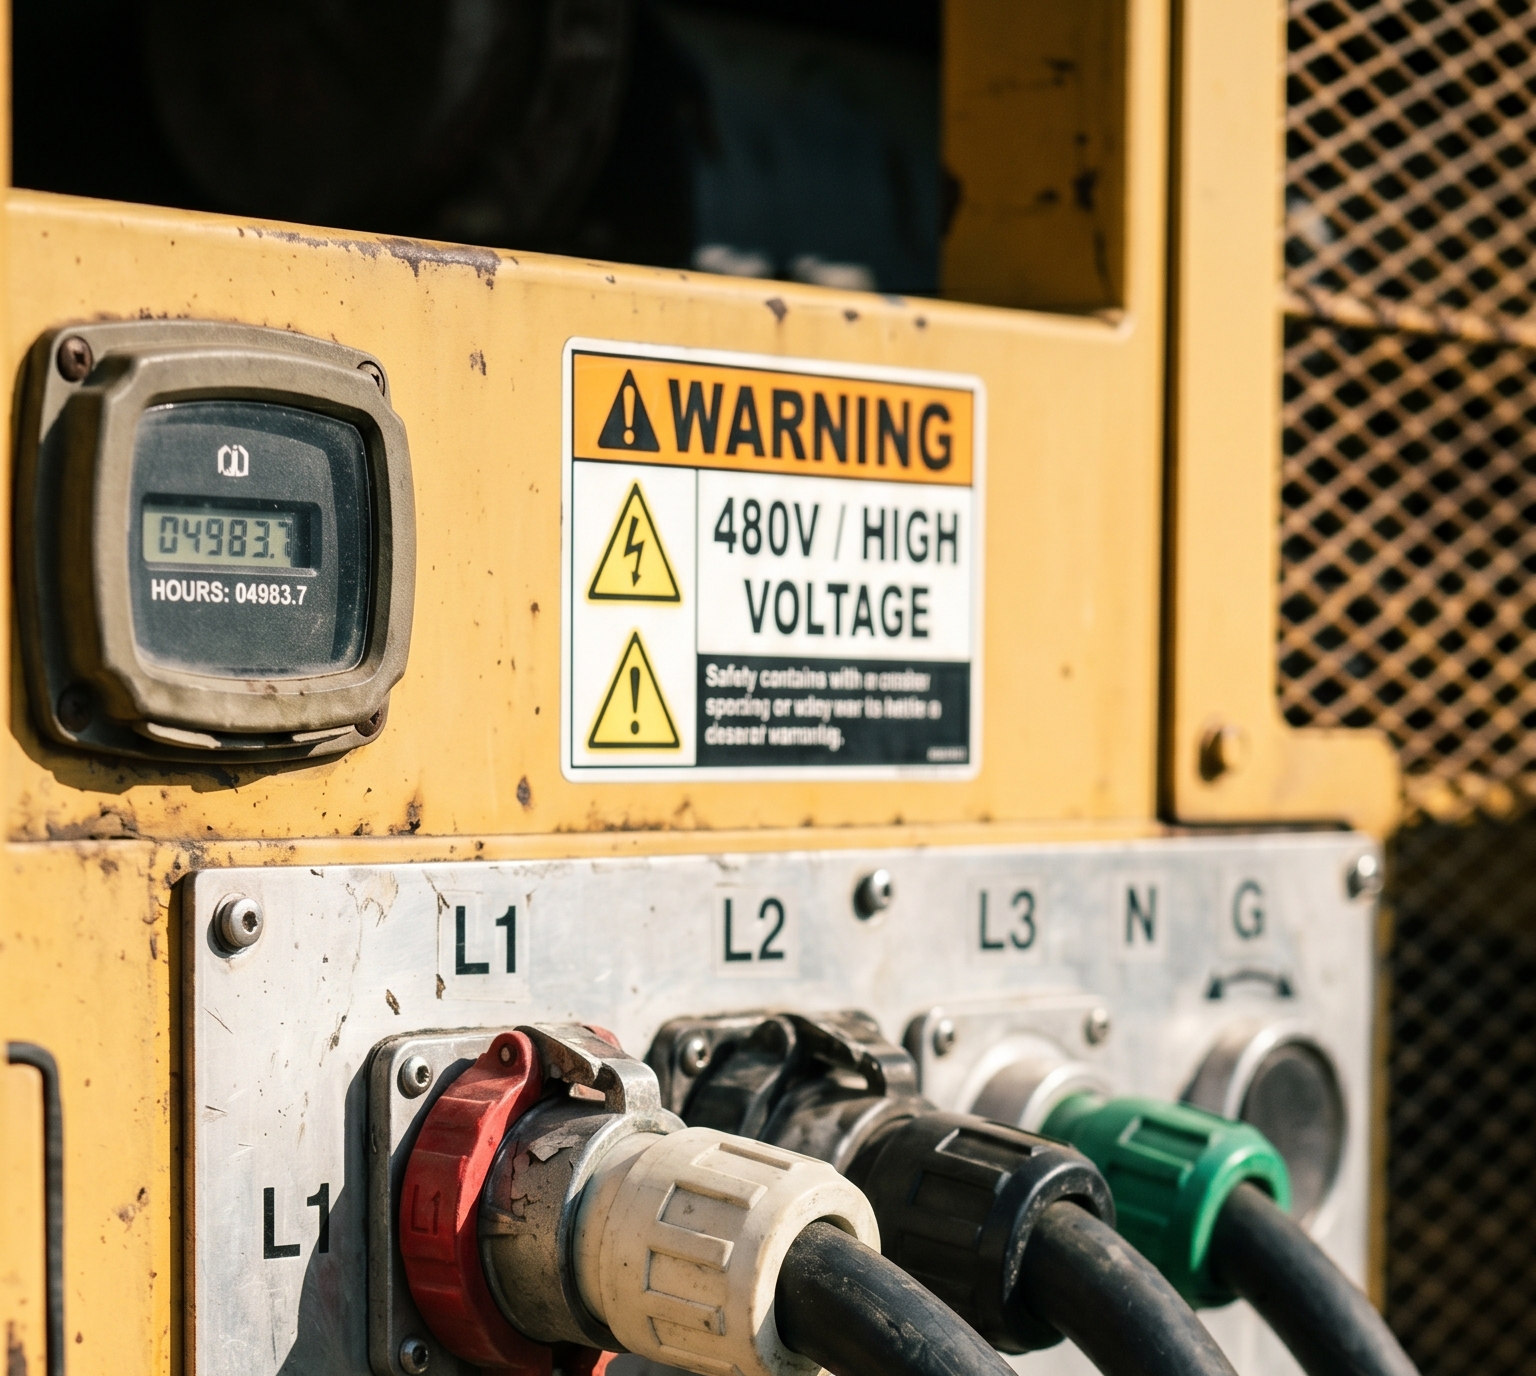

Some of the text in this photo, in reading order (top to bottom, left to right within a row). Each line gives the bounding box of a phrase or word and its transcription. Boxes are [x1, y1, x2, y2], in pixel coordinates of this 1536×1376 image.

[668, 378, 953, 471] WARNING
[714, 497, 958, 564] 480V / HIGH
[151, 578, 308, 605] HOURS: 04983.7
[744, 579, 931, 638] VOLTAGE
[705, 663, 757, 693] Safety
[455, 905, 518, 975] L1
[724, 897, 787, 963] L2
[979, 889, 1038, 951] L3
[1126, 884, 1157, 945] N
[1232, 880, 1267, 939] G
[263, 1182, 330, 1260] L1
[410, 1184, 441, 1236] L1
